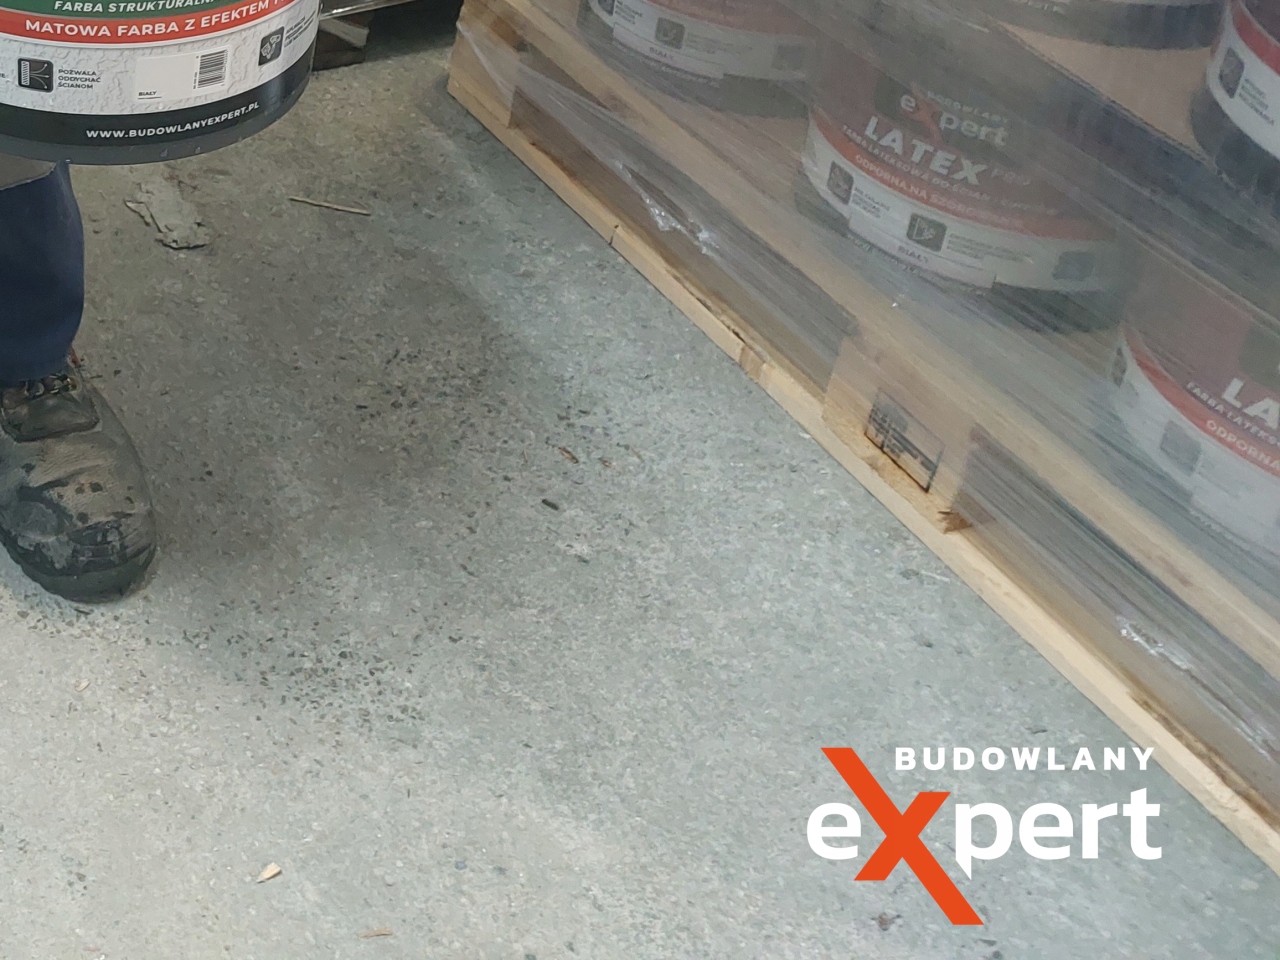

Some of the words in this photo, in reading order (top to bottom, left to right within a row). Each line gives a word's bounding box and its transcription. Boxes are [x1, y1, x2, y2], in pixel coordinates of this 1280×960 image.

[53, 0, 103, 14] FARBA
[25, 19, 112, 37] MATOWA
[117, 21, 180, 38] FARBA
[185, 18, 196, 31] Z
[58, 68, 97, 77] POZWALA
[58, 74, 102, 83] ODDYCHAĆ
[57, 81, 94, 90] ŚCIANOM
[85, 101, 260, 139] WWW.BUDOWLANYEXPERT.PL
[865, 115, 989, 185] LATEX
[1186, 381, 1224, 414] FARBA
